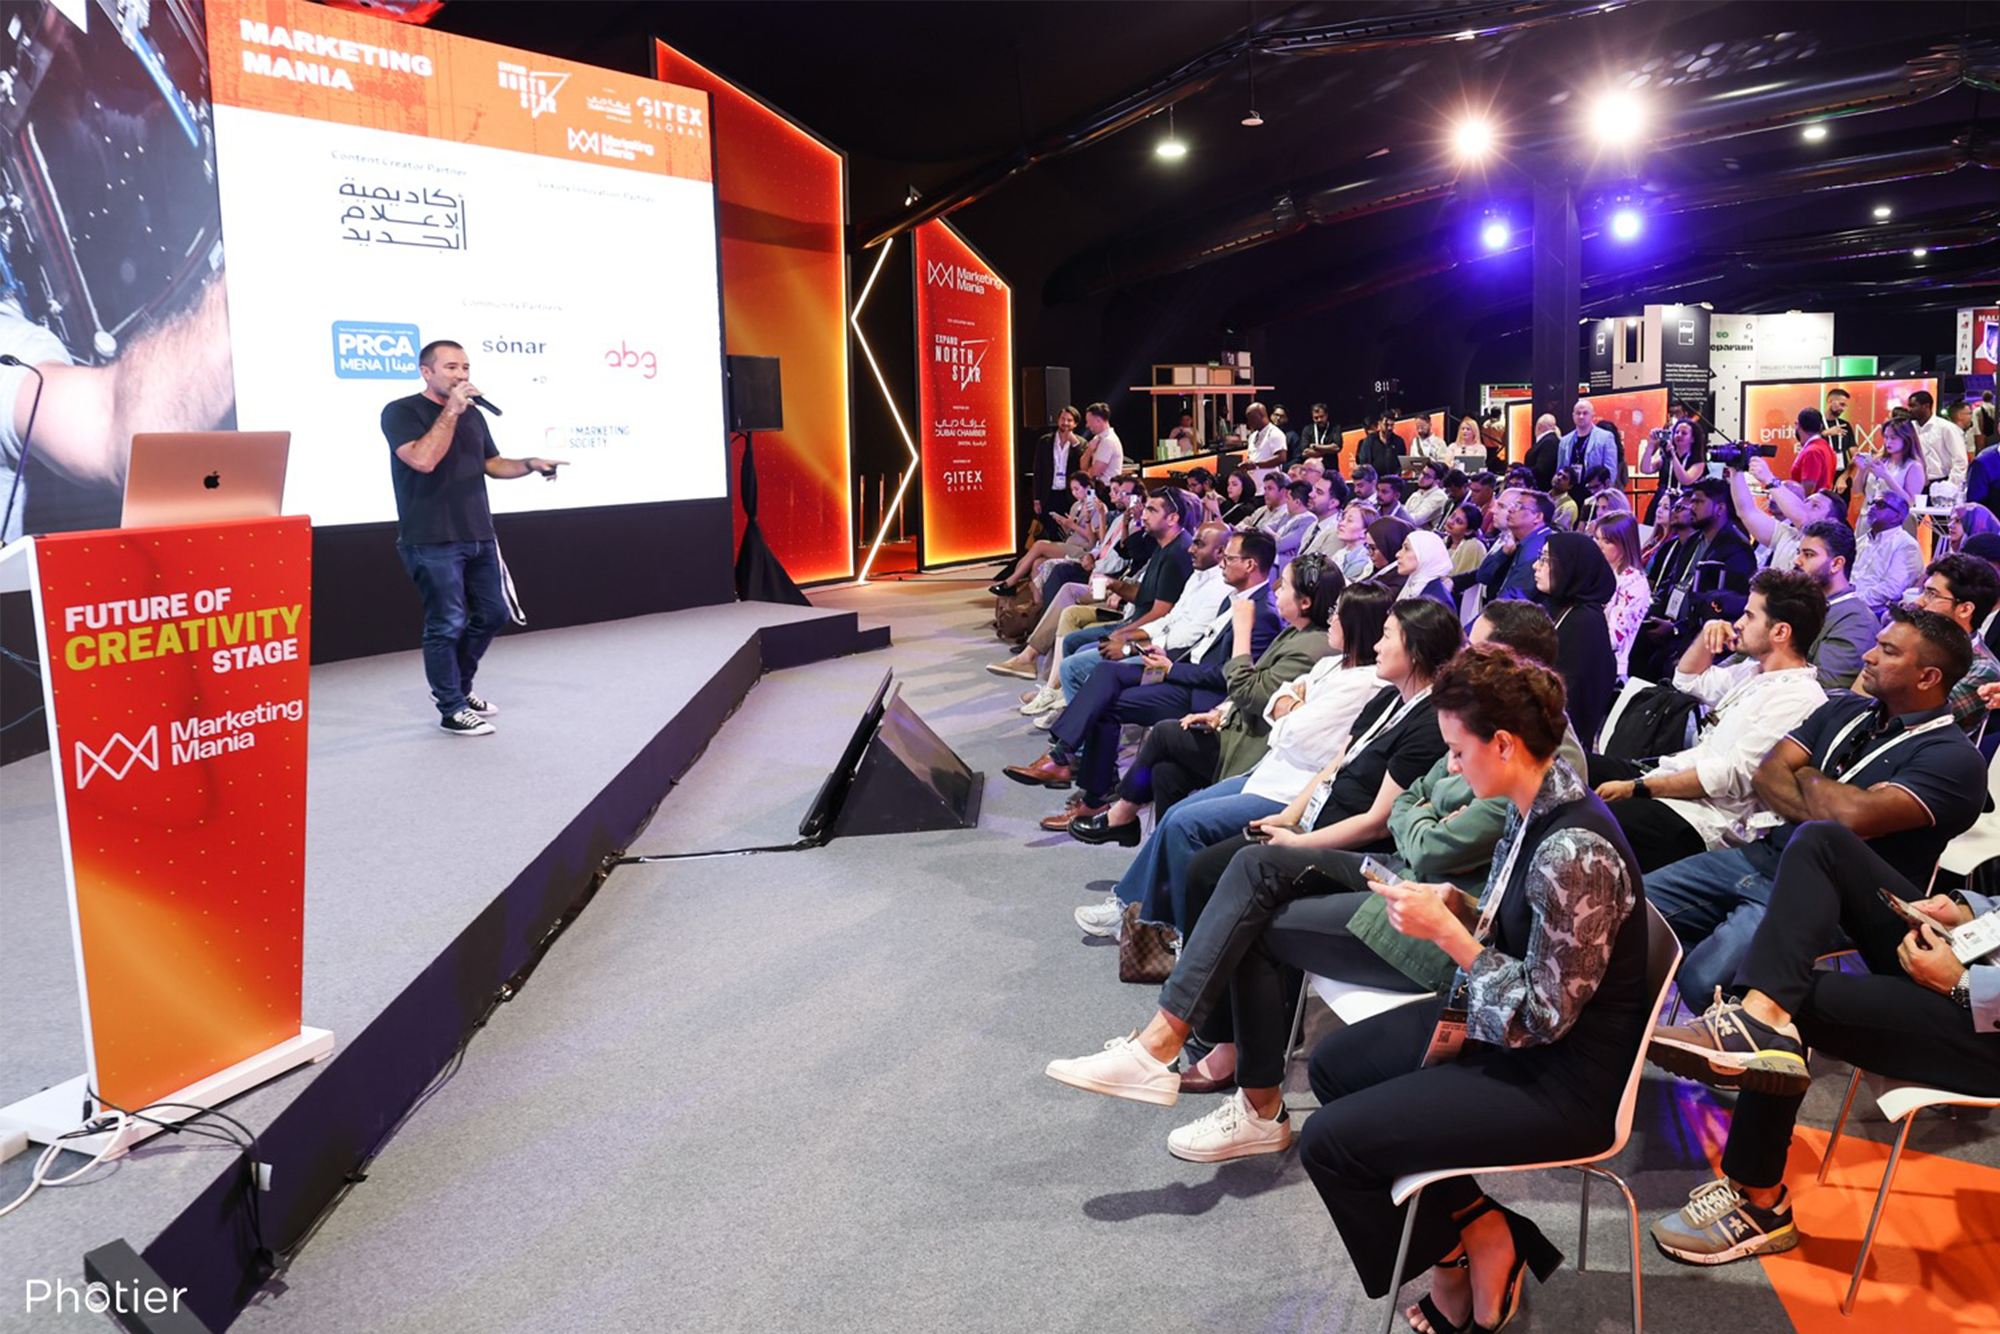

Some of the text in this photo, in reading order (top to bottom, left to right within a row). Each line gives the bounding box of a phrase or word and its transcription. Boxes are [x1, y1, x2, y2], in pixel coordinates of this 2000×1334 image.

[240, 18, 433, 77] MARKETING
[242, 50, 354, 91] MANIA
[636, 96, 703, 127] GITEX
[643, 118, 704, 138] GLOBAL
[331, 149, 468, 177] Content Creator Partner
[957, 266, 1003, 291] Marketing
[957, 279, 985, 295] Mania
[339, 333, 416, 357] PRCA
[935, 334, 958, 346] EXPAND
[340, 358, 384, 372] MENA
[604, 339, 658, 380] abg
[935, 345, 974, 365] NORTH
[951, 365, 982, 383] STAR
[569, 437, 608, 449] SOCIETY
[575, 425, 631, 437] MARKETING
[943, 470, 983, 485] GITEX
[947, 484, 984, 493] GLOBAL
[64, 587, 231, 632] FUTURE OF
[64, 604, 302, 671] CREATIVITY
[212, 638, 299, 673] STAGE
[170, 698, 303, 743] Marketing
[171, 730, 255, 766] Mania
